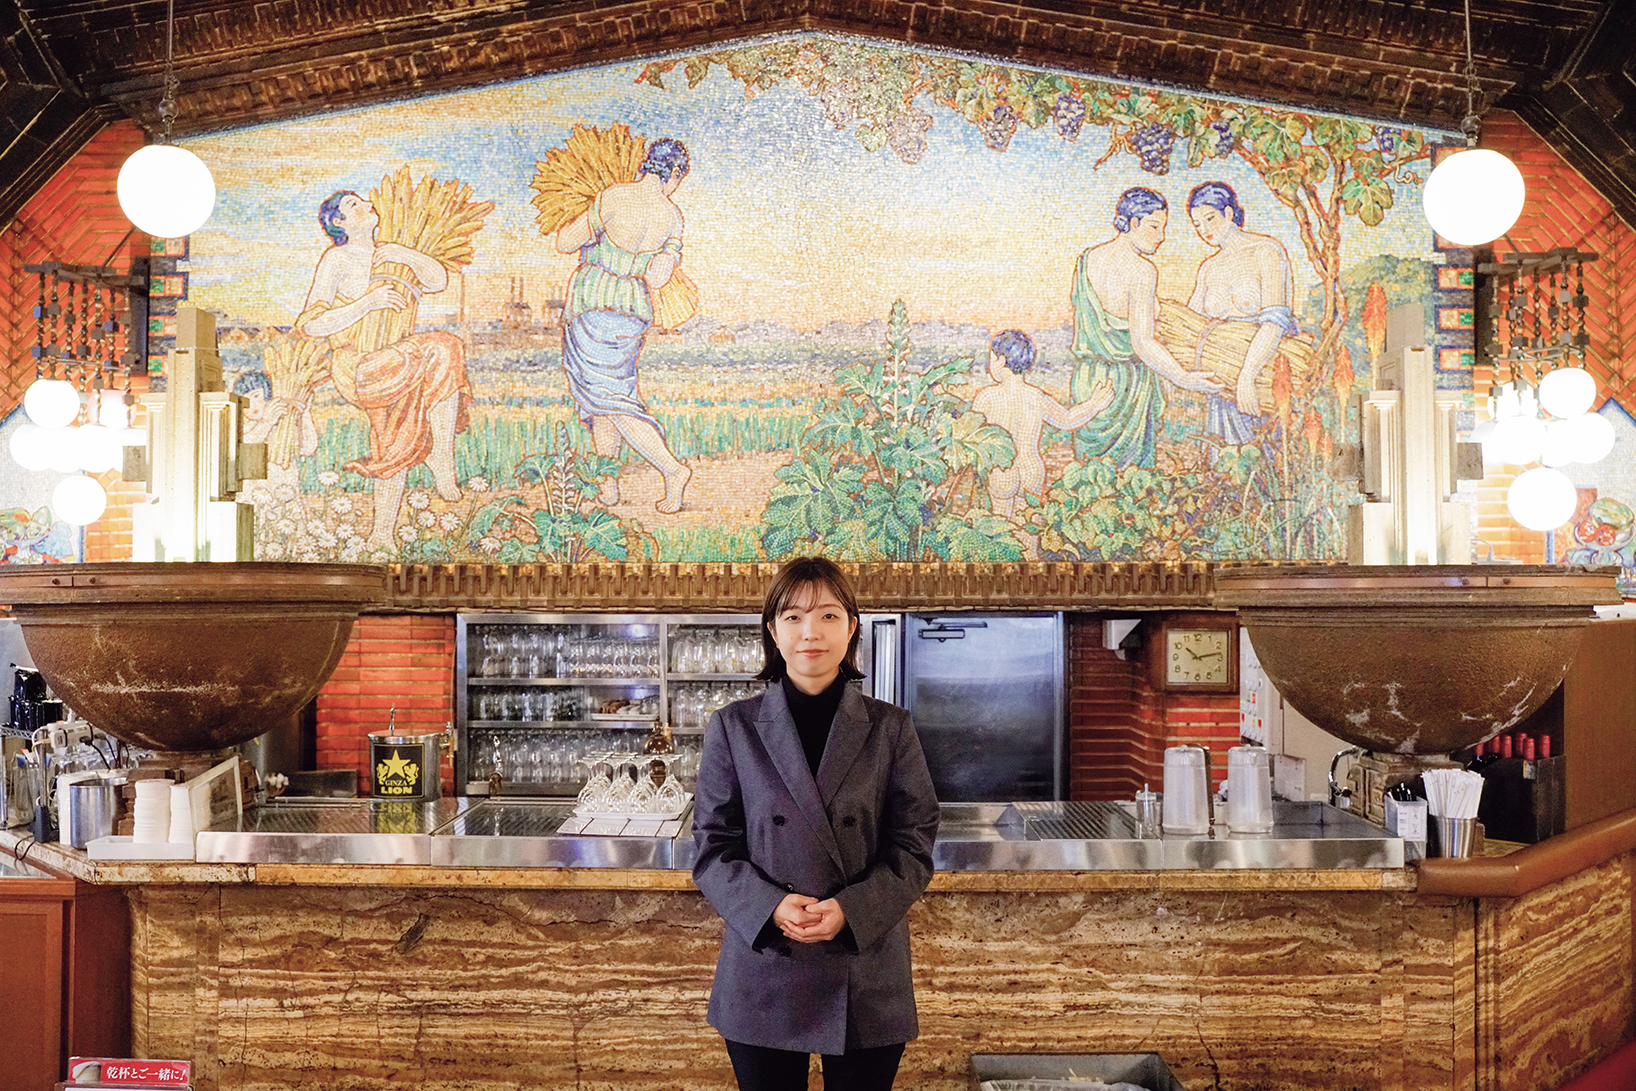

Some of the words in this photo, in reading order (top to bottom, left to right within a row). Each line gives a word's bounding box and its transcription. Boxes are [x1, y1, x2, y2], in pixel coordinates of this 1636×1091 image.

[381, 786, 413, 795] LION
[106, 1066, 187, 1081] 乾杯とご一緒に!
